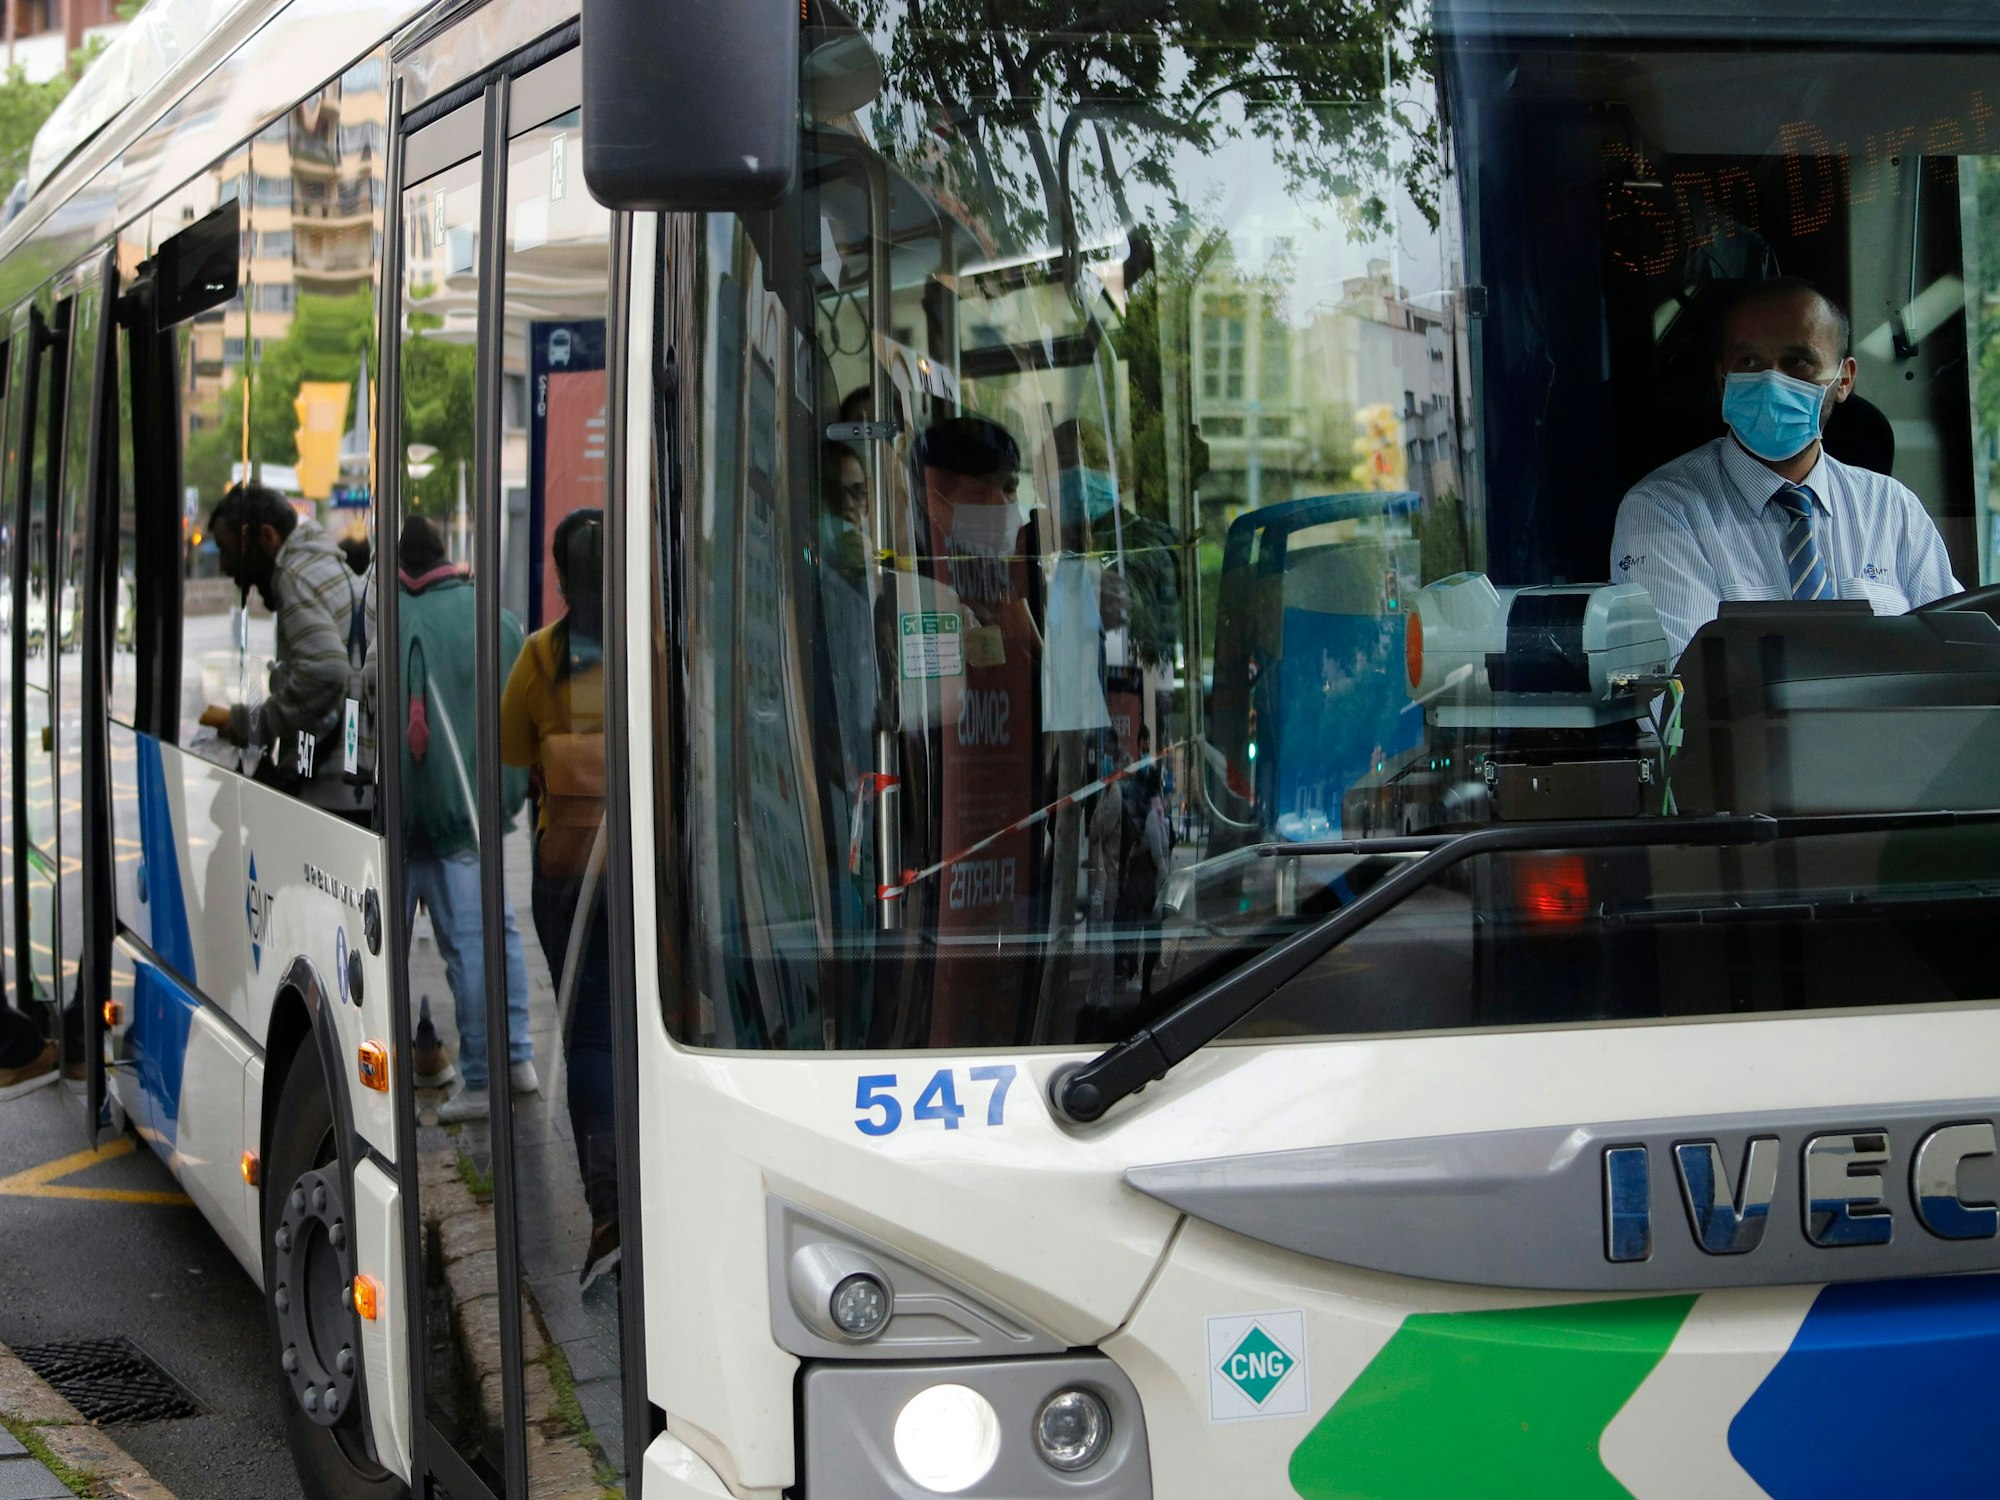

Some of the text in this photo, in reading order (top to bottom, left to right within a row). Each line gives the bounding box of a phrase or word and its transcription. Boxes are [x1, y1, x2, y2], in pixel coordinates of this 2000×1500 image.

[945, 620, 956, 630] L1
[297, 730, 316, 779] 547
[854, 1064, 1017, 1136] 547
[1231, 1350, 1285, 1380] CNG
